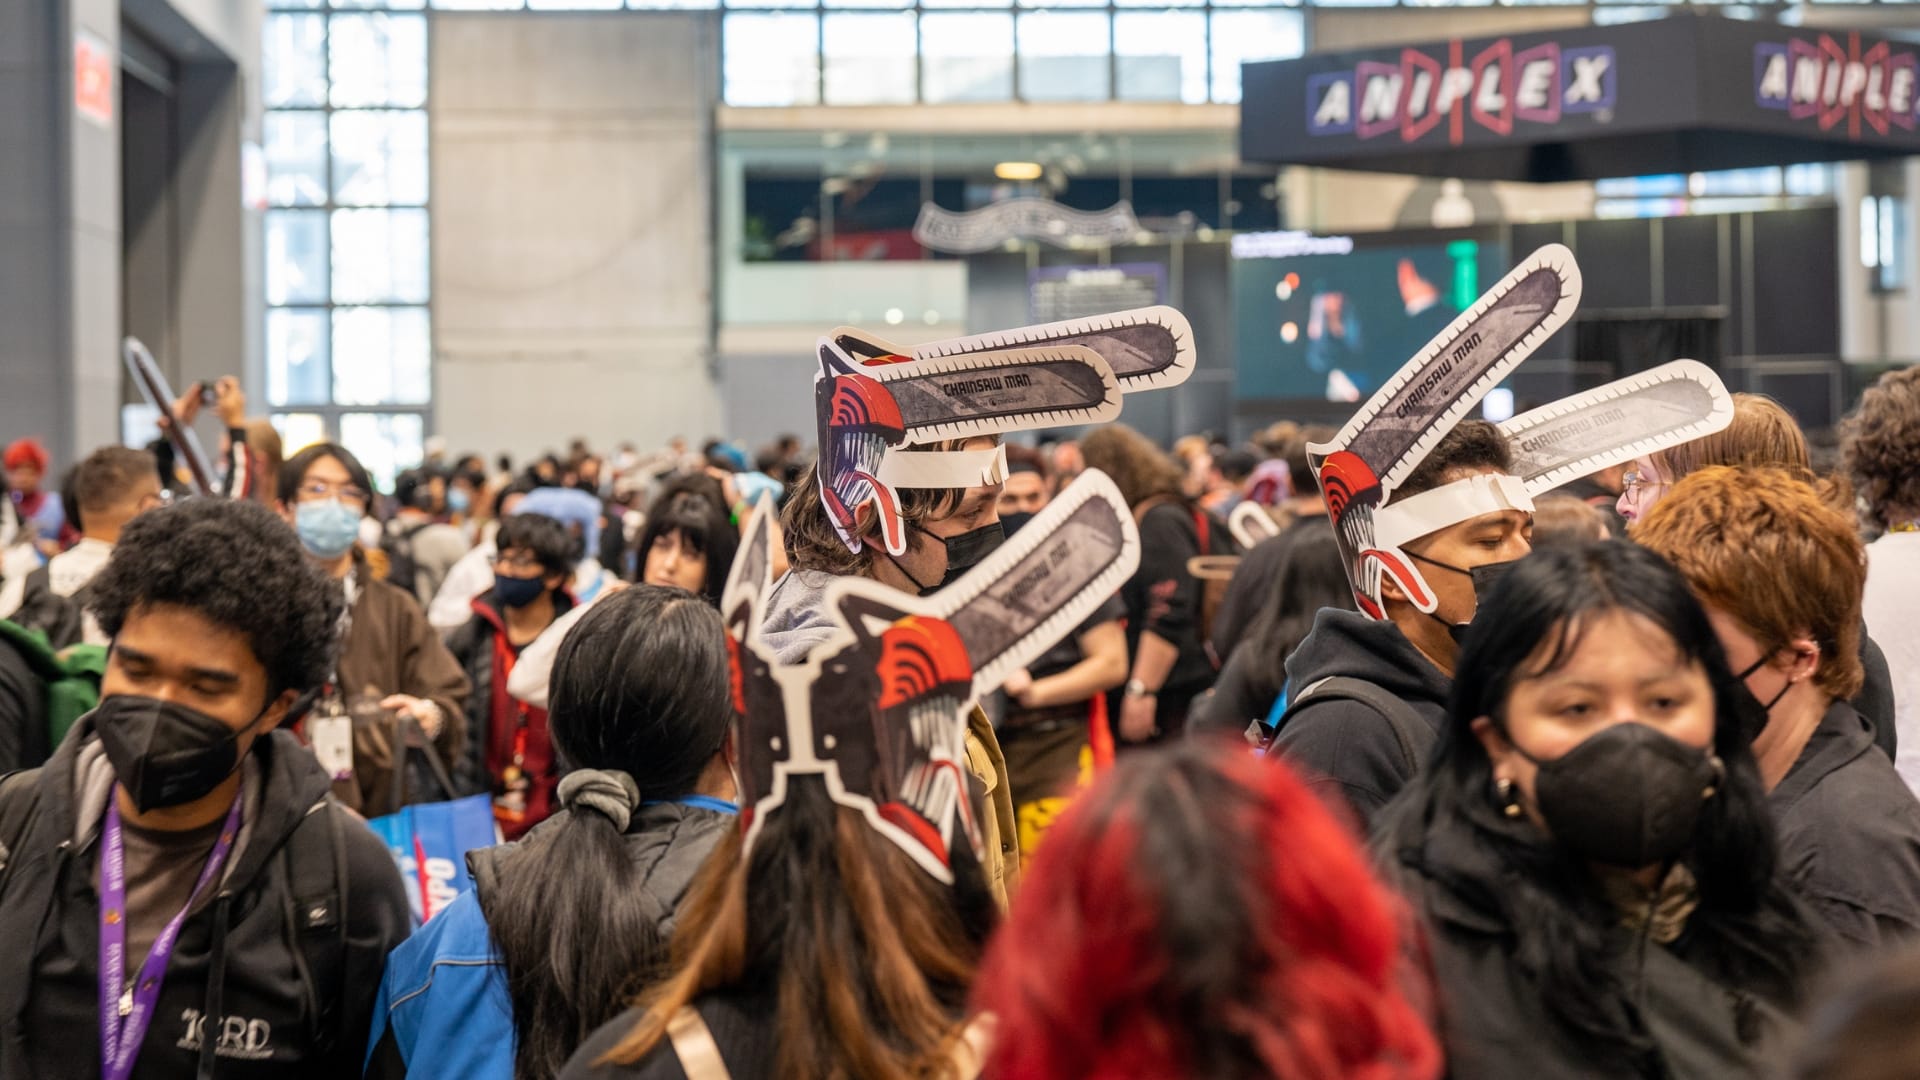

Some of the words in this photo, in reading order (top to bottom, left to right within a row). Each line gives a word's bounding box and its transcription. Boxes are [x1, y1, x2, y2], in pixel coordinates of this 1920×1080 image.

[1314, 54, 1611, 126] ANIPLEX
[1759, 53, 1920, 113] ANIPLE
[943, 375, 1003, 397] CHAINSAW
[1004, 373, 1032, 389] MAN
[1396, 359, 1453, 419] CHAINSAW
[1452, 332, 1482, 365] MAN
[1521, 419, 1594, 453] CHAINSAW
[1592, 408, 1625, 426] MAN
